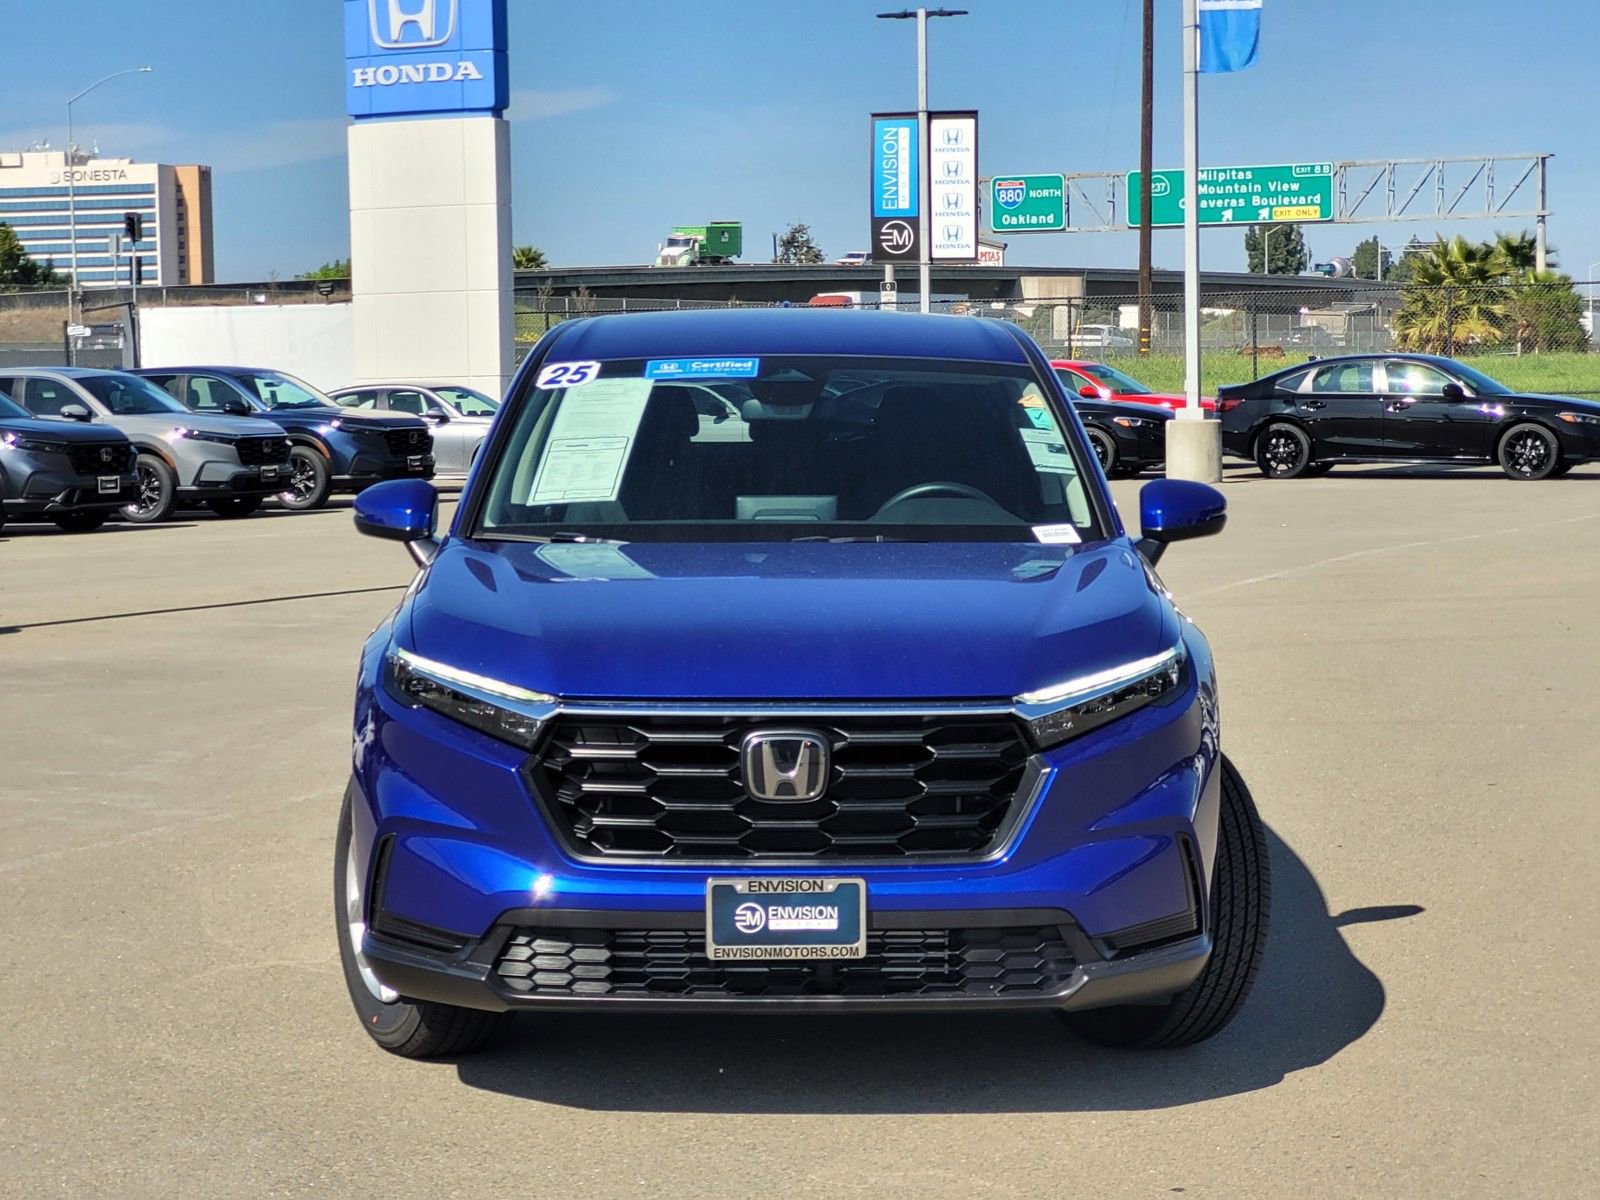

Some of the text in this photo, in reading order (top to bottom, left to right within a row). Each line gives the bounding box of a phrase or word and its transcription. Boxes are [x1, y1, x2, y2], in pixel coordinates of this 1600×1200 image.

[352, 61, 483, 87] HONDA
[882, 127, 898, 210] ENVISION
[63, 169, 128, 182] SONESTA
[1198, 170, 1253, 183] Milpitas
[1029, 188, 1061, 198] NORTH
[1198, 181, 1300, 195] Mountain View
[999, 189, 1023, 203] 880
[1178, 193, 1321, 209] Caveras Boulevard
[1001, 213, 1054, 225] Oakland
[1273, 208, 1318, 218] EXIT ONLY
[690, 361, 753, 369] Certified
[543, 365, 593, 385] 25
[747, 880, 824, 893] ENVISION
[768, 905, 838, 919] ENVISION
[713, 946, 860, 959] ENVISIONMOTORS.COM
